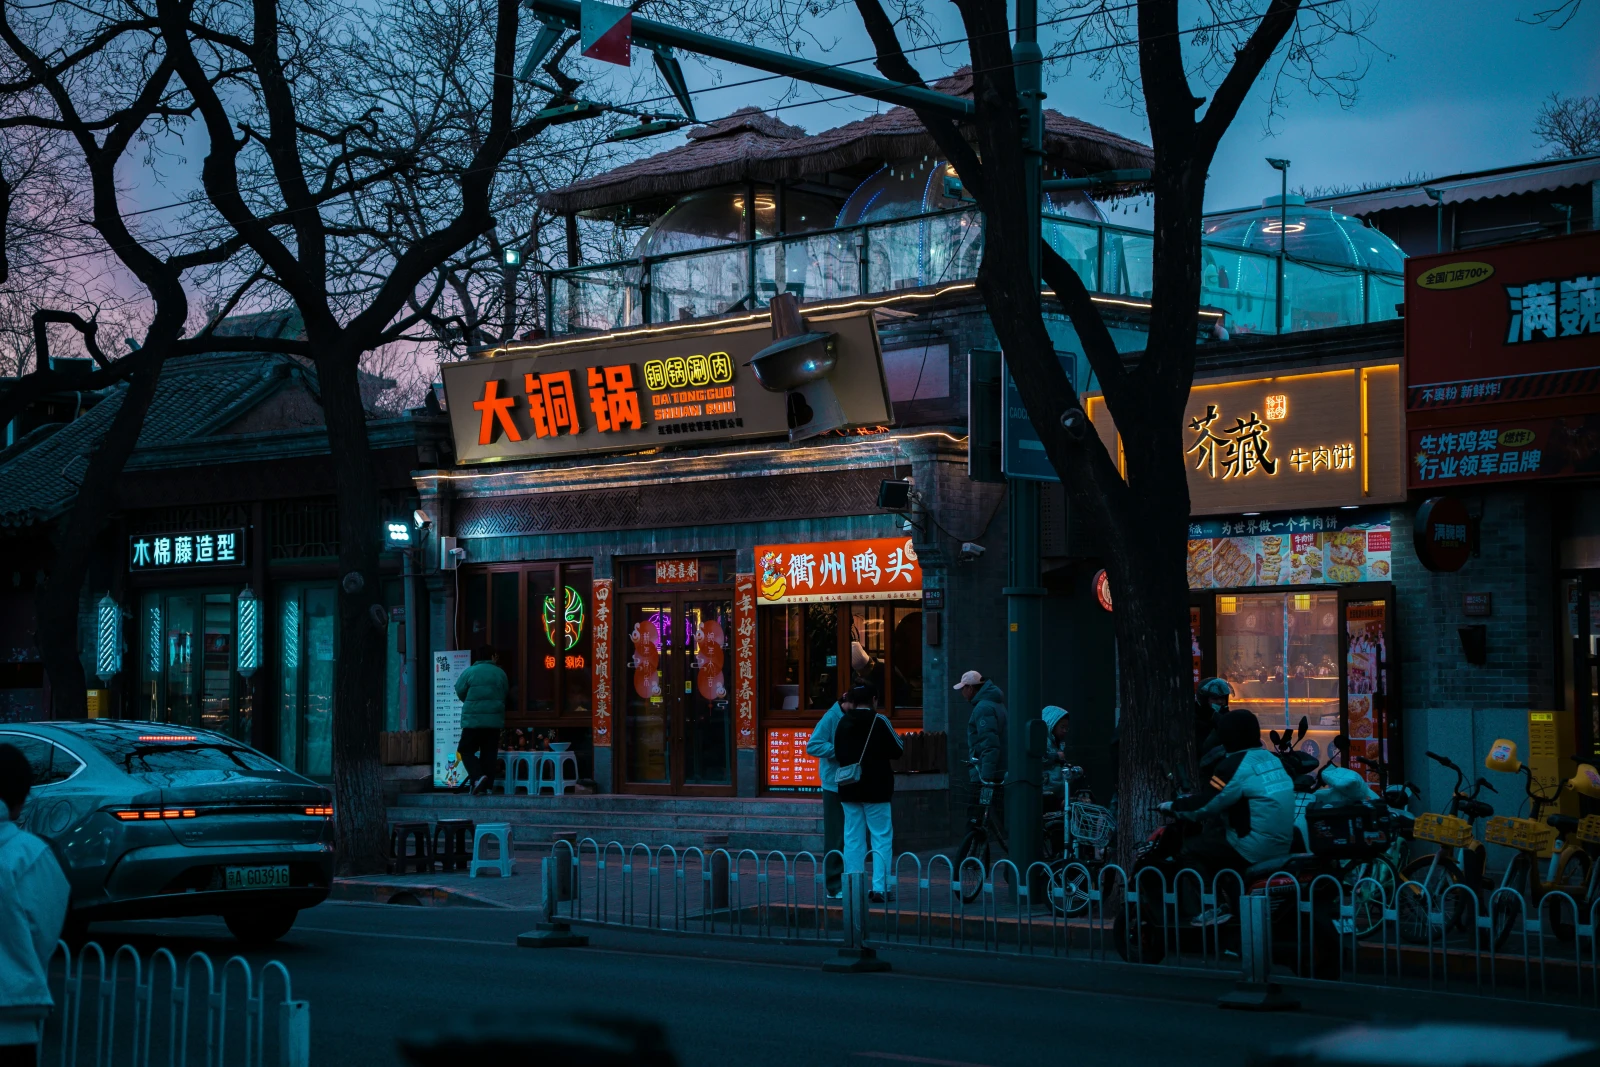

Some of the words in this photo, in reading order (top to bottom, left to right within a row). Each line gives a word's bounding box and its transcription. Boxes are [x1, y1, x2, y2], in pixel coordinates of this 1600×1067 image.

[1425, 267, 1489, 286] 全国门店700+
[645, 354, 730, 388] 铜锅涮肉
[472, 364, 642, 446] 大铜锅
[1422, 387, 1457, 403] 不裹粉
[653, 405, 702, 421] SHUAN
[705, 400, 736, 416] ROU
[1187, 404, 1279, 480] 芥藏
[1420, 429, 1498, 455] 生炸鸡架
[1289, 443, 1355, 473] 牛肉饼
[1420, 449, 1542, 480] 行业领军品牌
[1221, 515, 1338, 535] 为世界做一个牛肉饼
[133, 533, 236, 566] 木棉藤造型
[787, 547, 915, 590] 衢州鸭头
